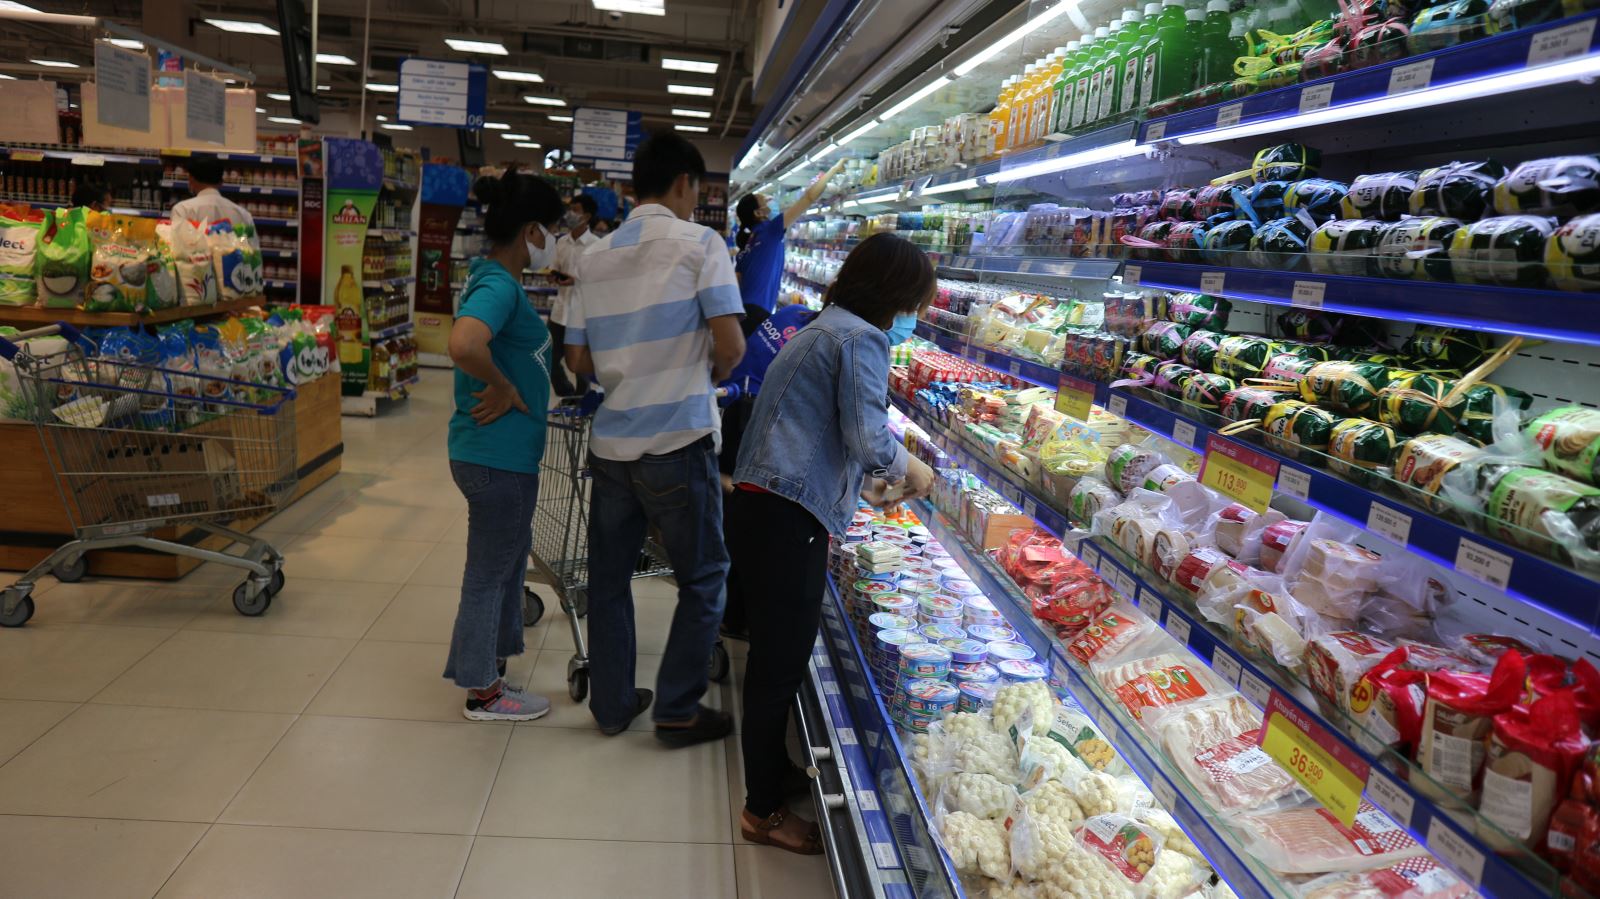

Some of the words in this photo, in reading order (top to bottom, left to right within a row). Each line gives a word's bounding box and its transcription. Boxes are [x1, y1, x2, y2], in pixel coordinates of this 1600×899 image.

[467, 114, 484, 127] 06
[927, 703, 938, 711] 16
[1057, 715, 1079, 734] Select
